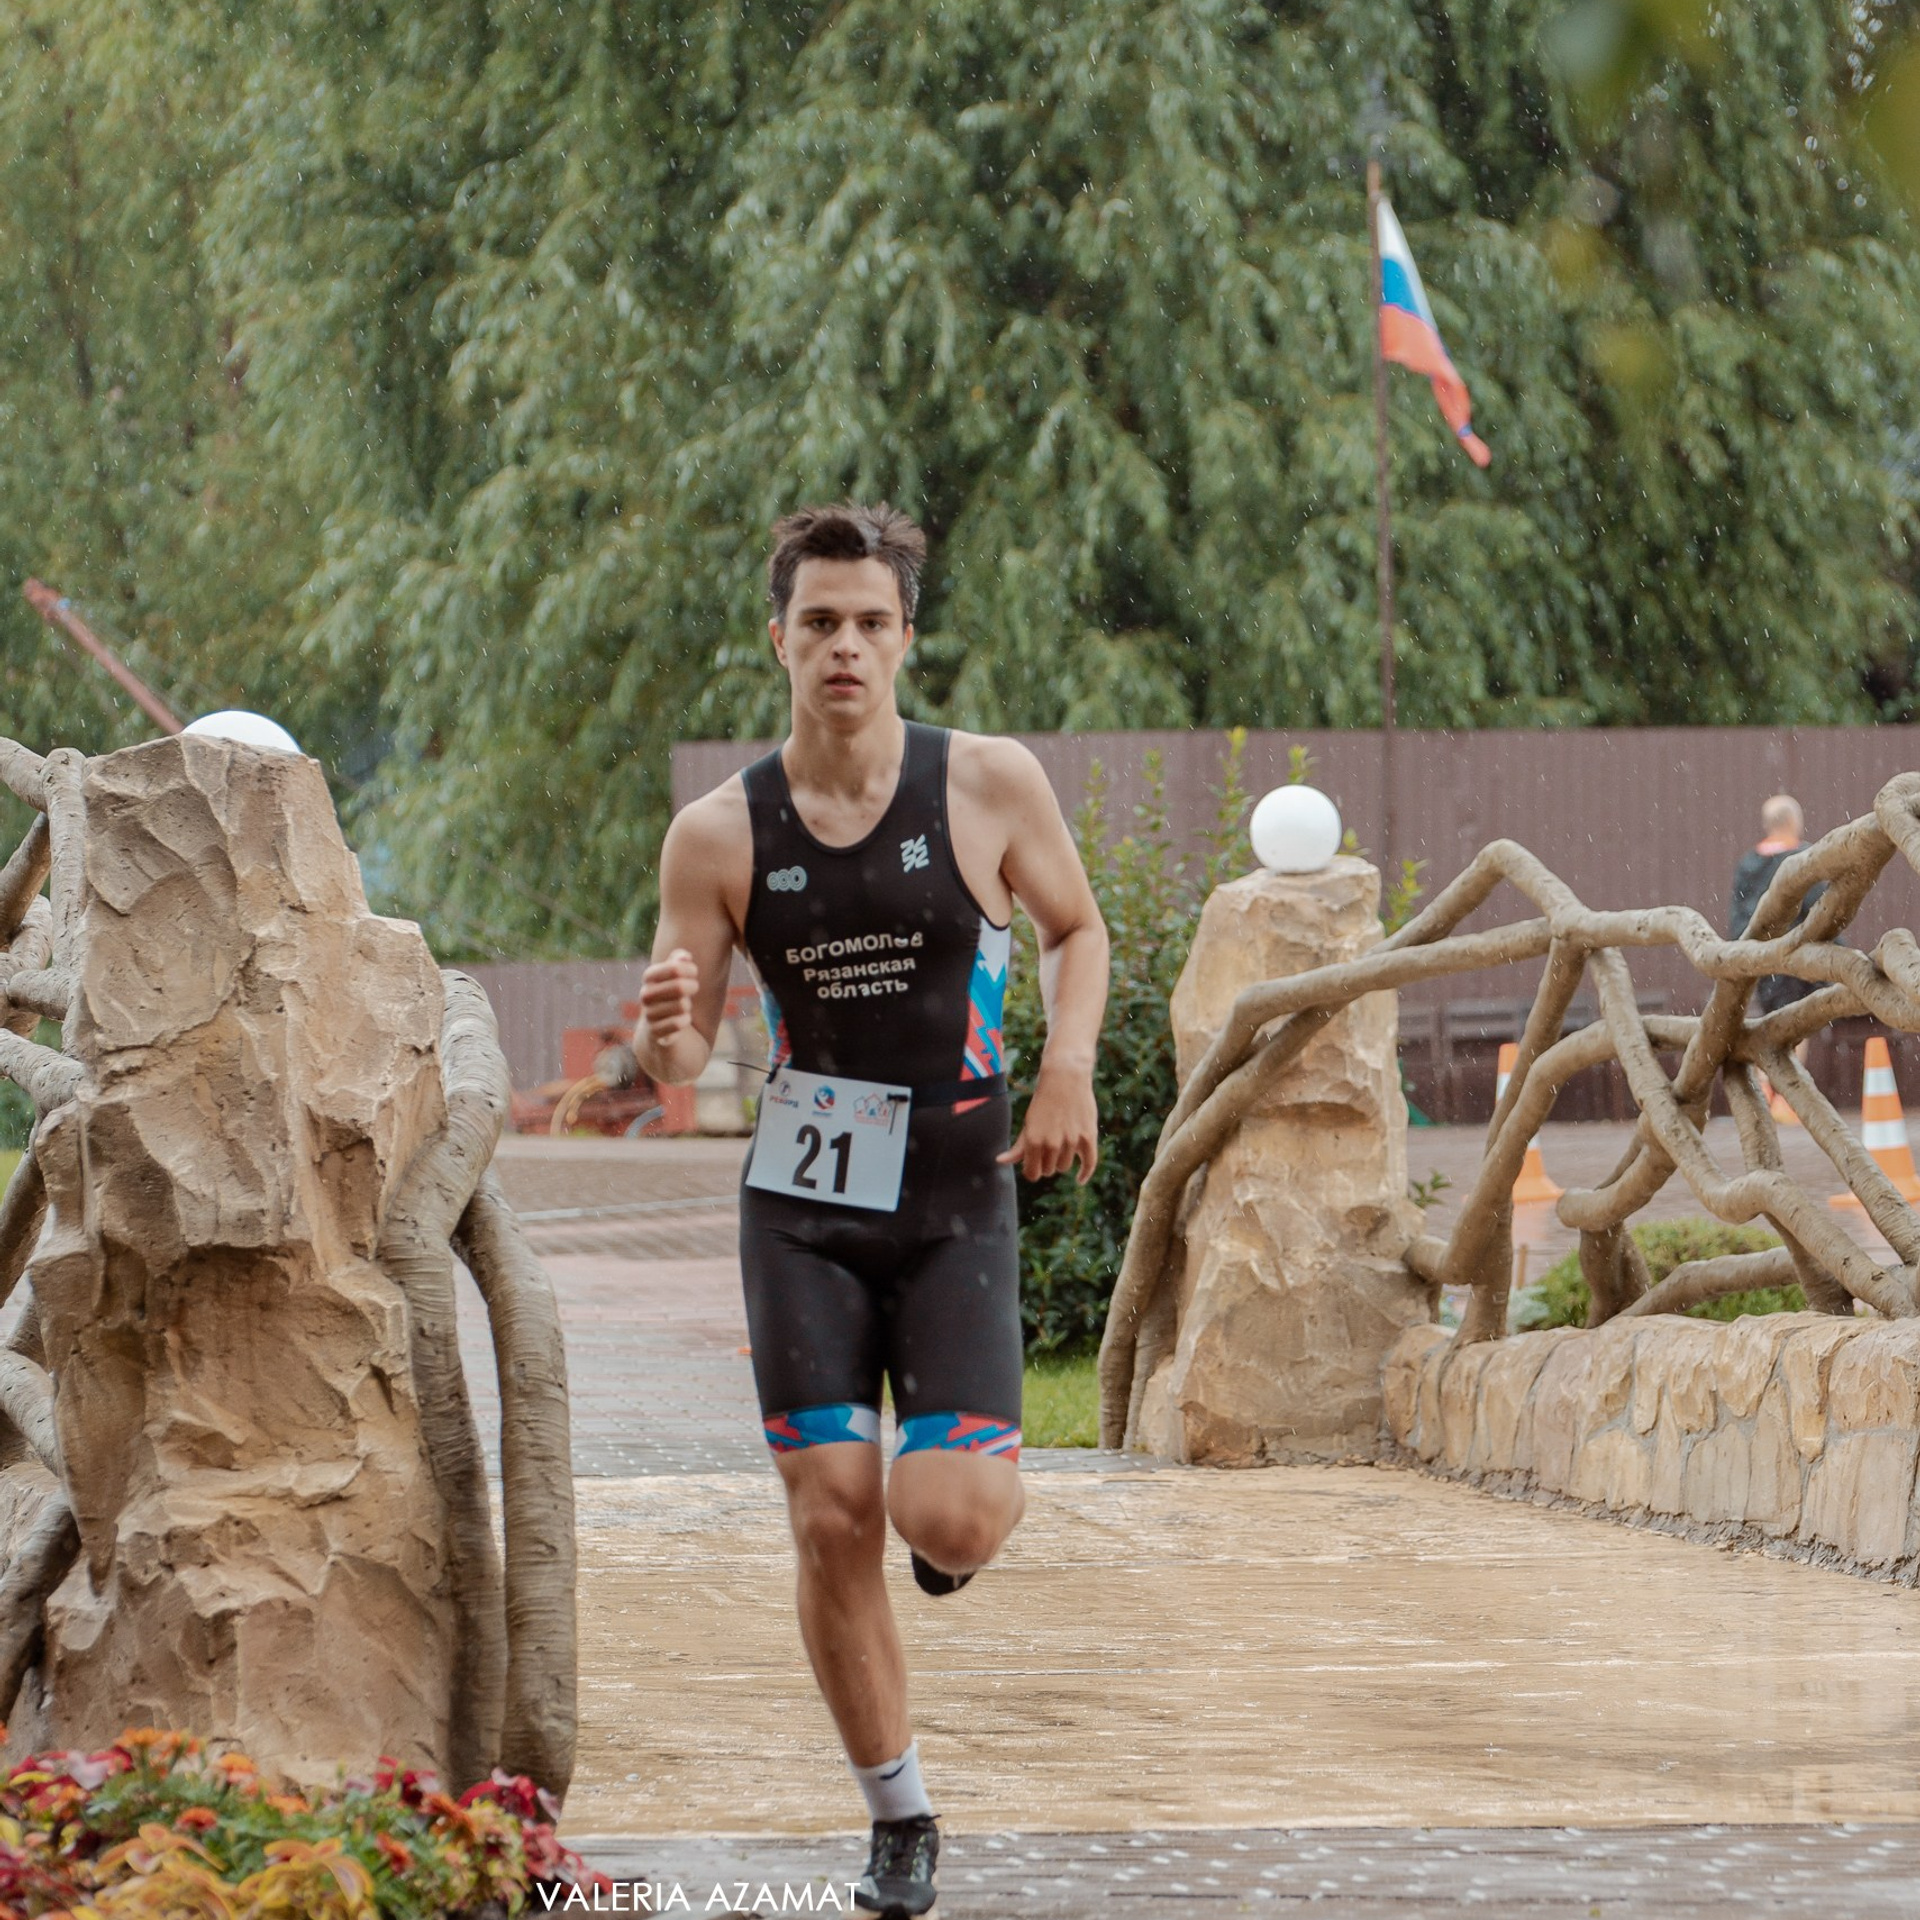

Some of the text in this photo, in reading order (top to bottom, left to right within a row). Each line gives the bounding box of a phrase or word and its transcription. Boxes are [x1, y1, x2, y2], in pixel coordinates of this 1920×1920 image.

[803, 957, 916, 982] Рязанская
[817, 979, 909, 999] область
[792, 1124, 853, 1194] 21
